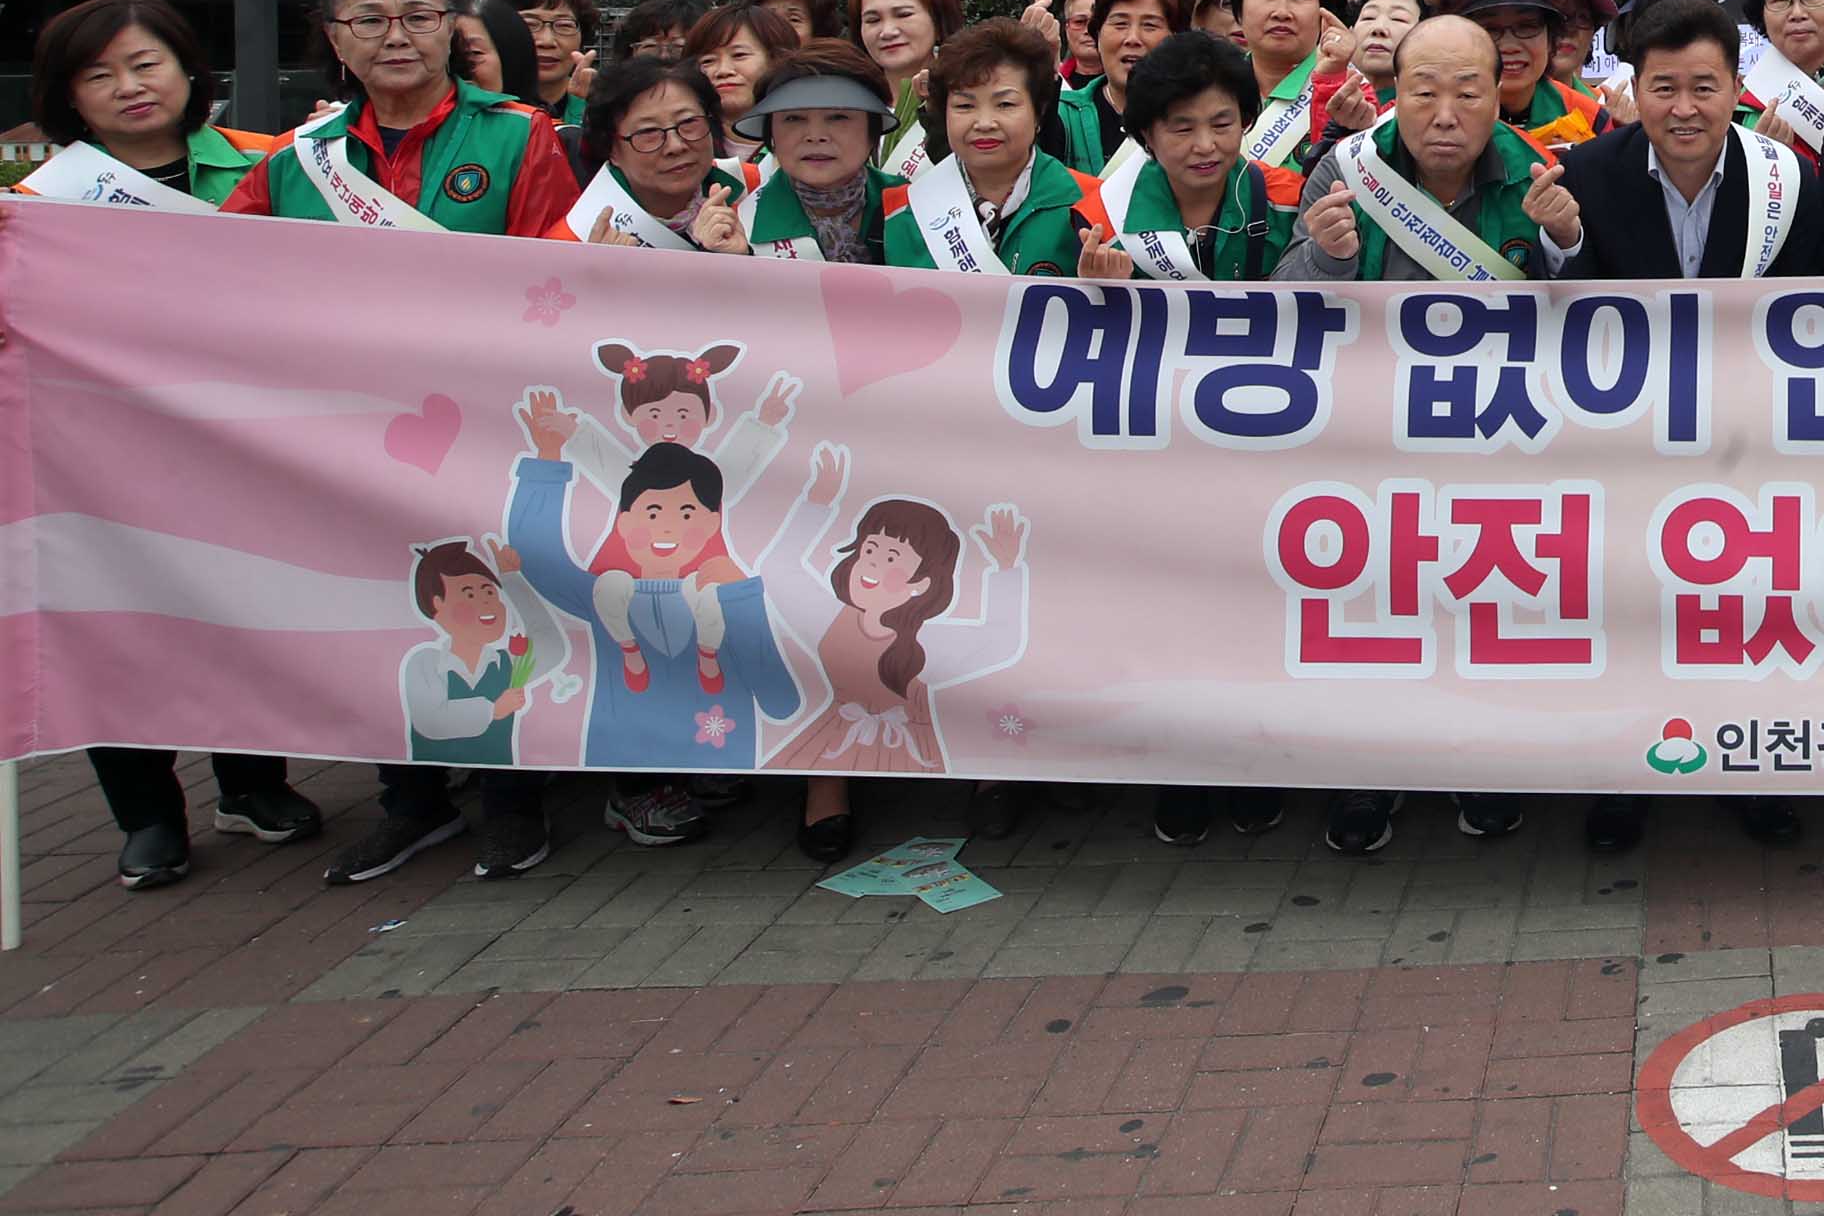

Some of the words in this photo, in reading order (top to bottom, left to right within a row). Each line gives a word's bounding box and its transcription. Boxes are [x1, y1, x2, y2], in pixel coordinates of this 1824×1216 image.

[1391, 201, 1472, 272] 안전점검의
[1007, 285, 1346, 438] 예방
[1400, 291, 1698, 442] 없이
[1278, 492, 1593, 665] 안전
